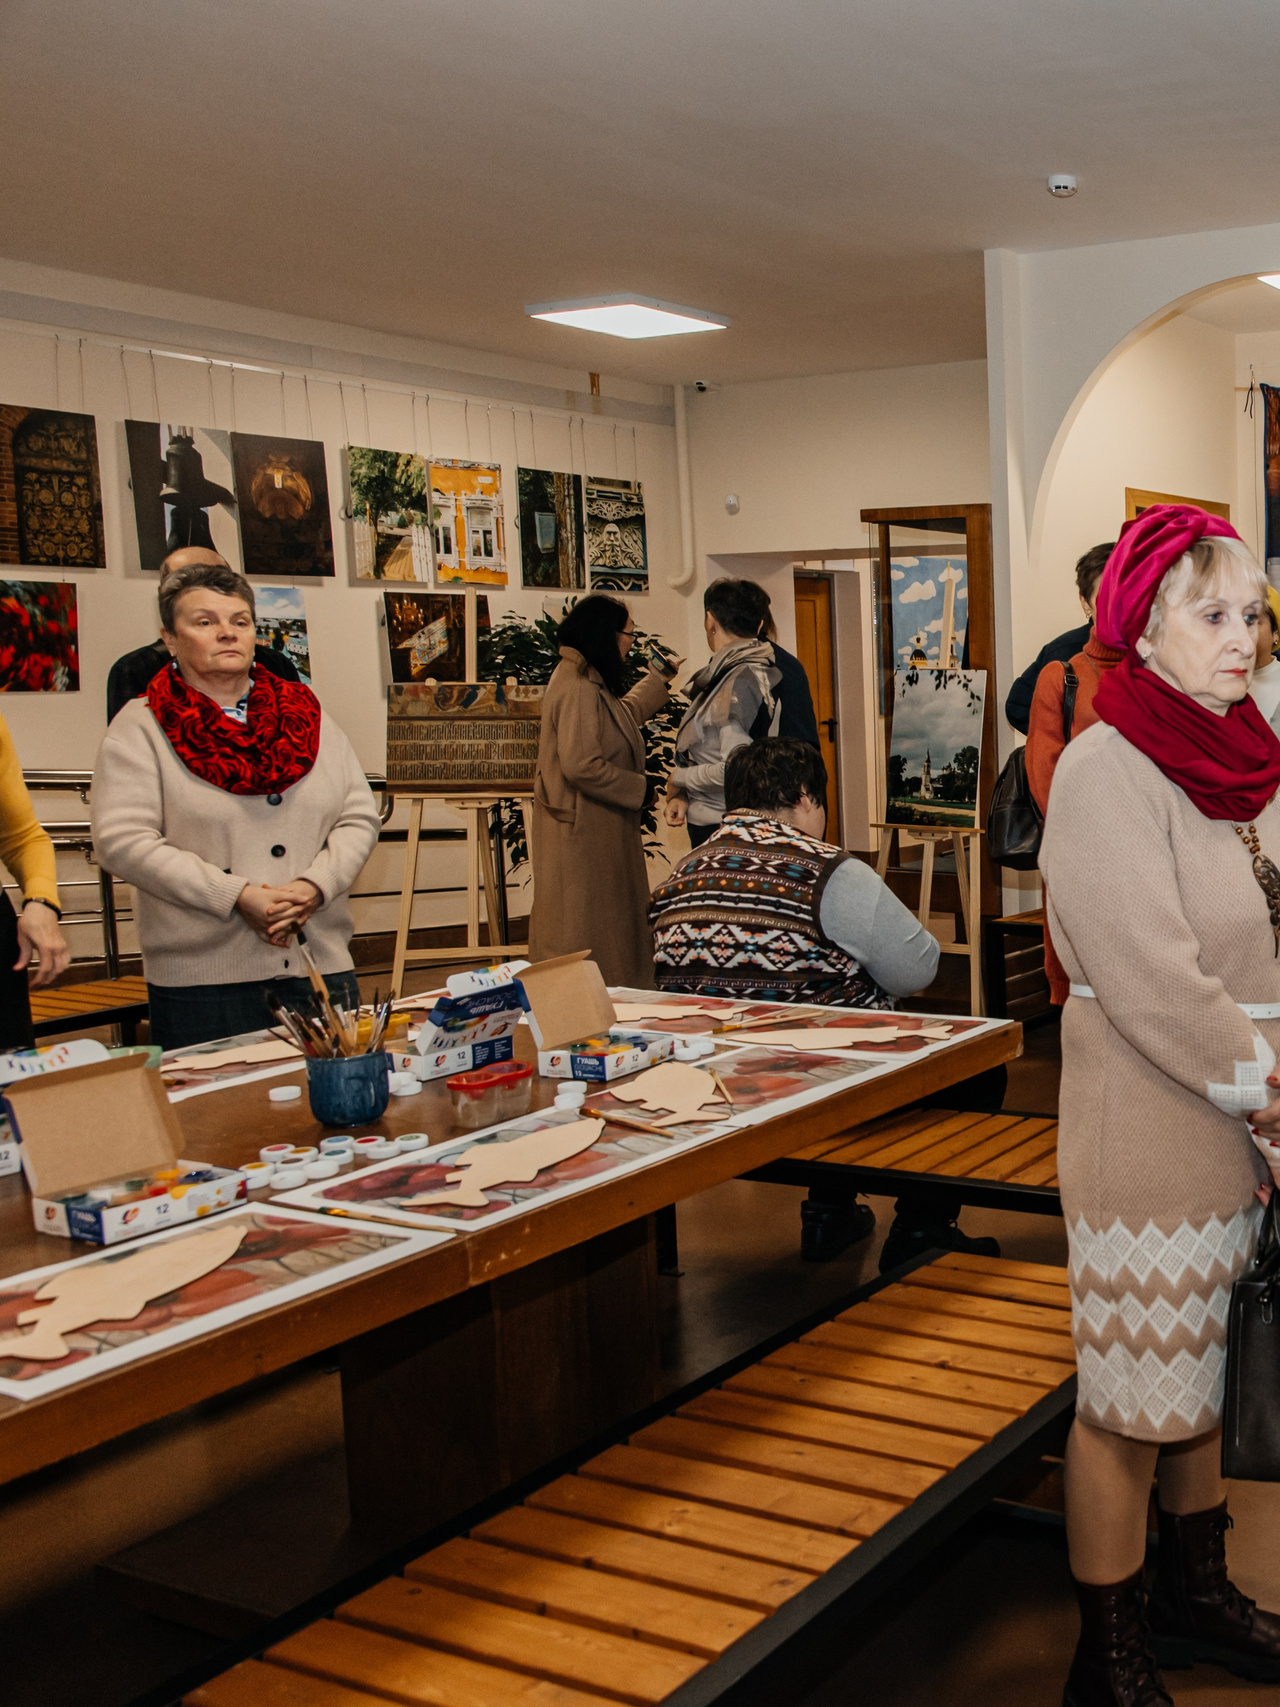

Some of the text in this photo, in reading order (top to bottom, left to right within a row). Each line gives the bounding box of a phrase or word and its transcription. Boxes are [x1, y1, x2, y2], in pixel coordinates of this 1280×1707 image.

[470, 1001, 504, 1014] ГУАШЬ
[577, 1057, 599, 1065] ГУАШЬ
[156, 1203, 169, 1214] 12
